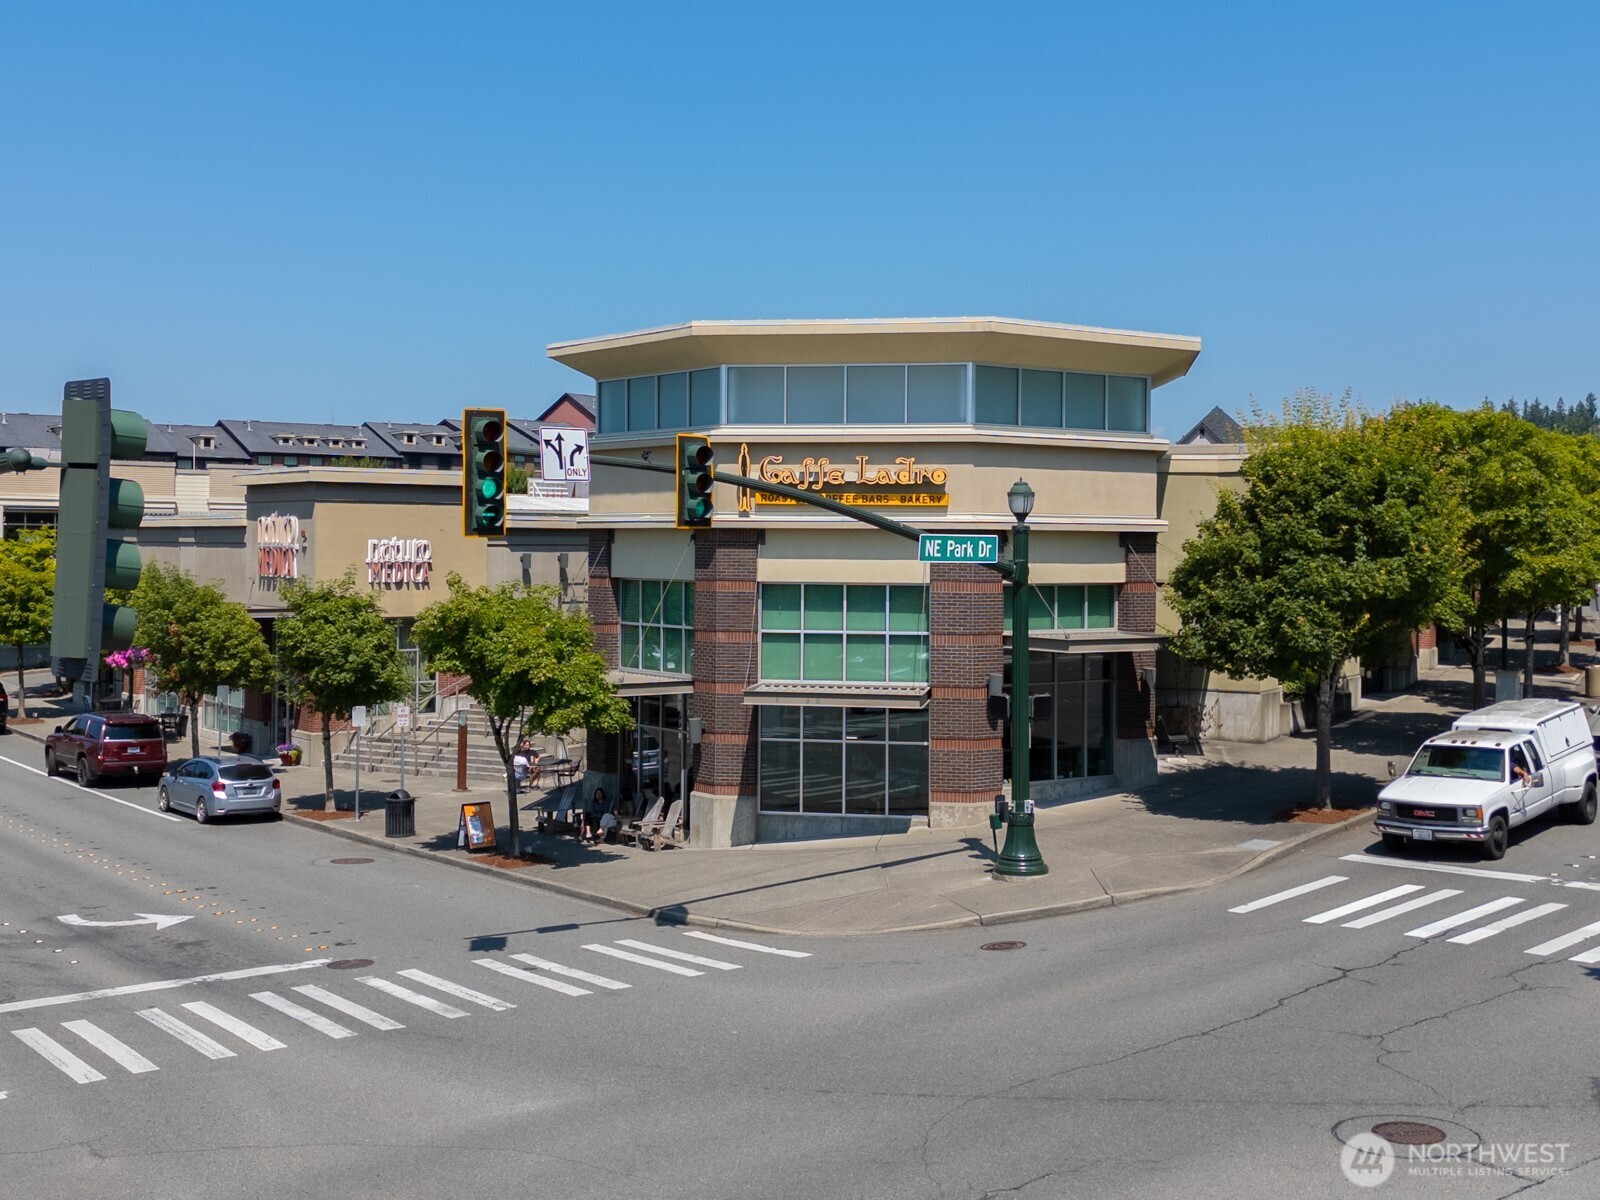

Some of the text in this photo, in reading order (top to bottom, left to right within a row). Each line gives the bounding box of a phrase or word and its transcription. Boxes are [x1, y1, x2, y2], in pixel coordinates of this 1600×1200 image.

[566, 468, 587, 477] ONLY
[758, 455, 949, 490] Caffe Ladro
[861, 494, 889, 504] BARS
[900, 495, 943, 504] BAKERY
[925, 539, 992, 558] NE Park Dr
[368, 560, 431, 583] MEDICA
